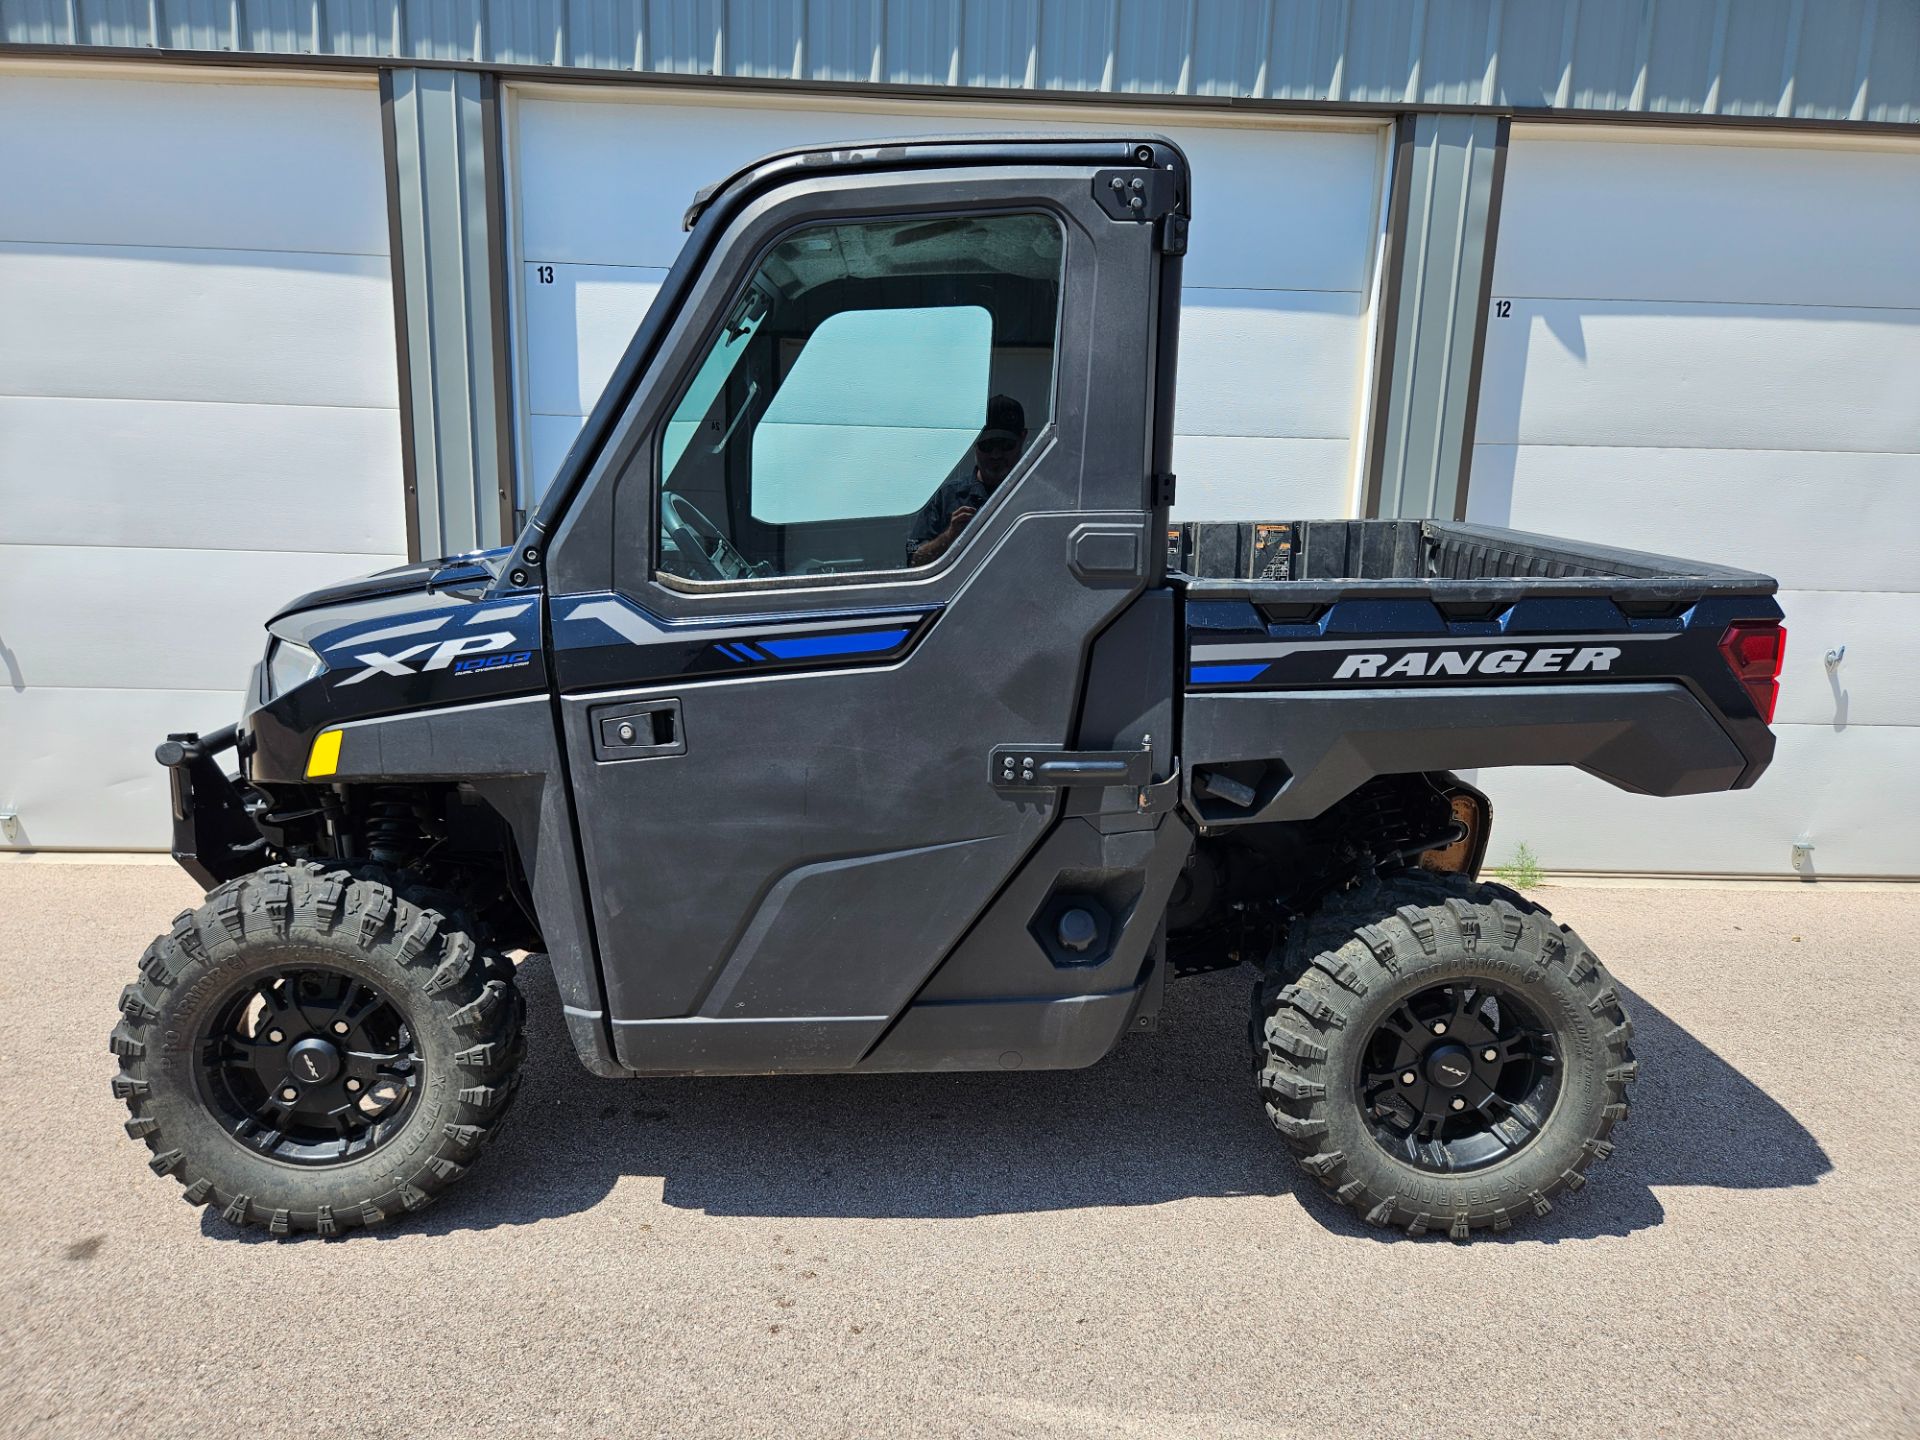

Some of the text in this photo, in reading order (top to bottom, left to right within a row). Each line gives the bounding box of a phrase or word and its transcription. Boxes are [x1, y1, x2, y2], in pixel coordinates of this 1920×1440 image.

[537, 266, 554, 284] 13
[1496, 300, 1511, 318] 12
[333, 631, 517, 688] XP
[454, 651, 532, 672] 1000
[1333, 646, 1622, 679] RANGER
[370, 1070, 447, 1183] X-TERRAIN
[1396, 1172, 1529, 1207] X-TERRAIN
